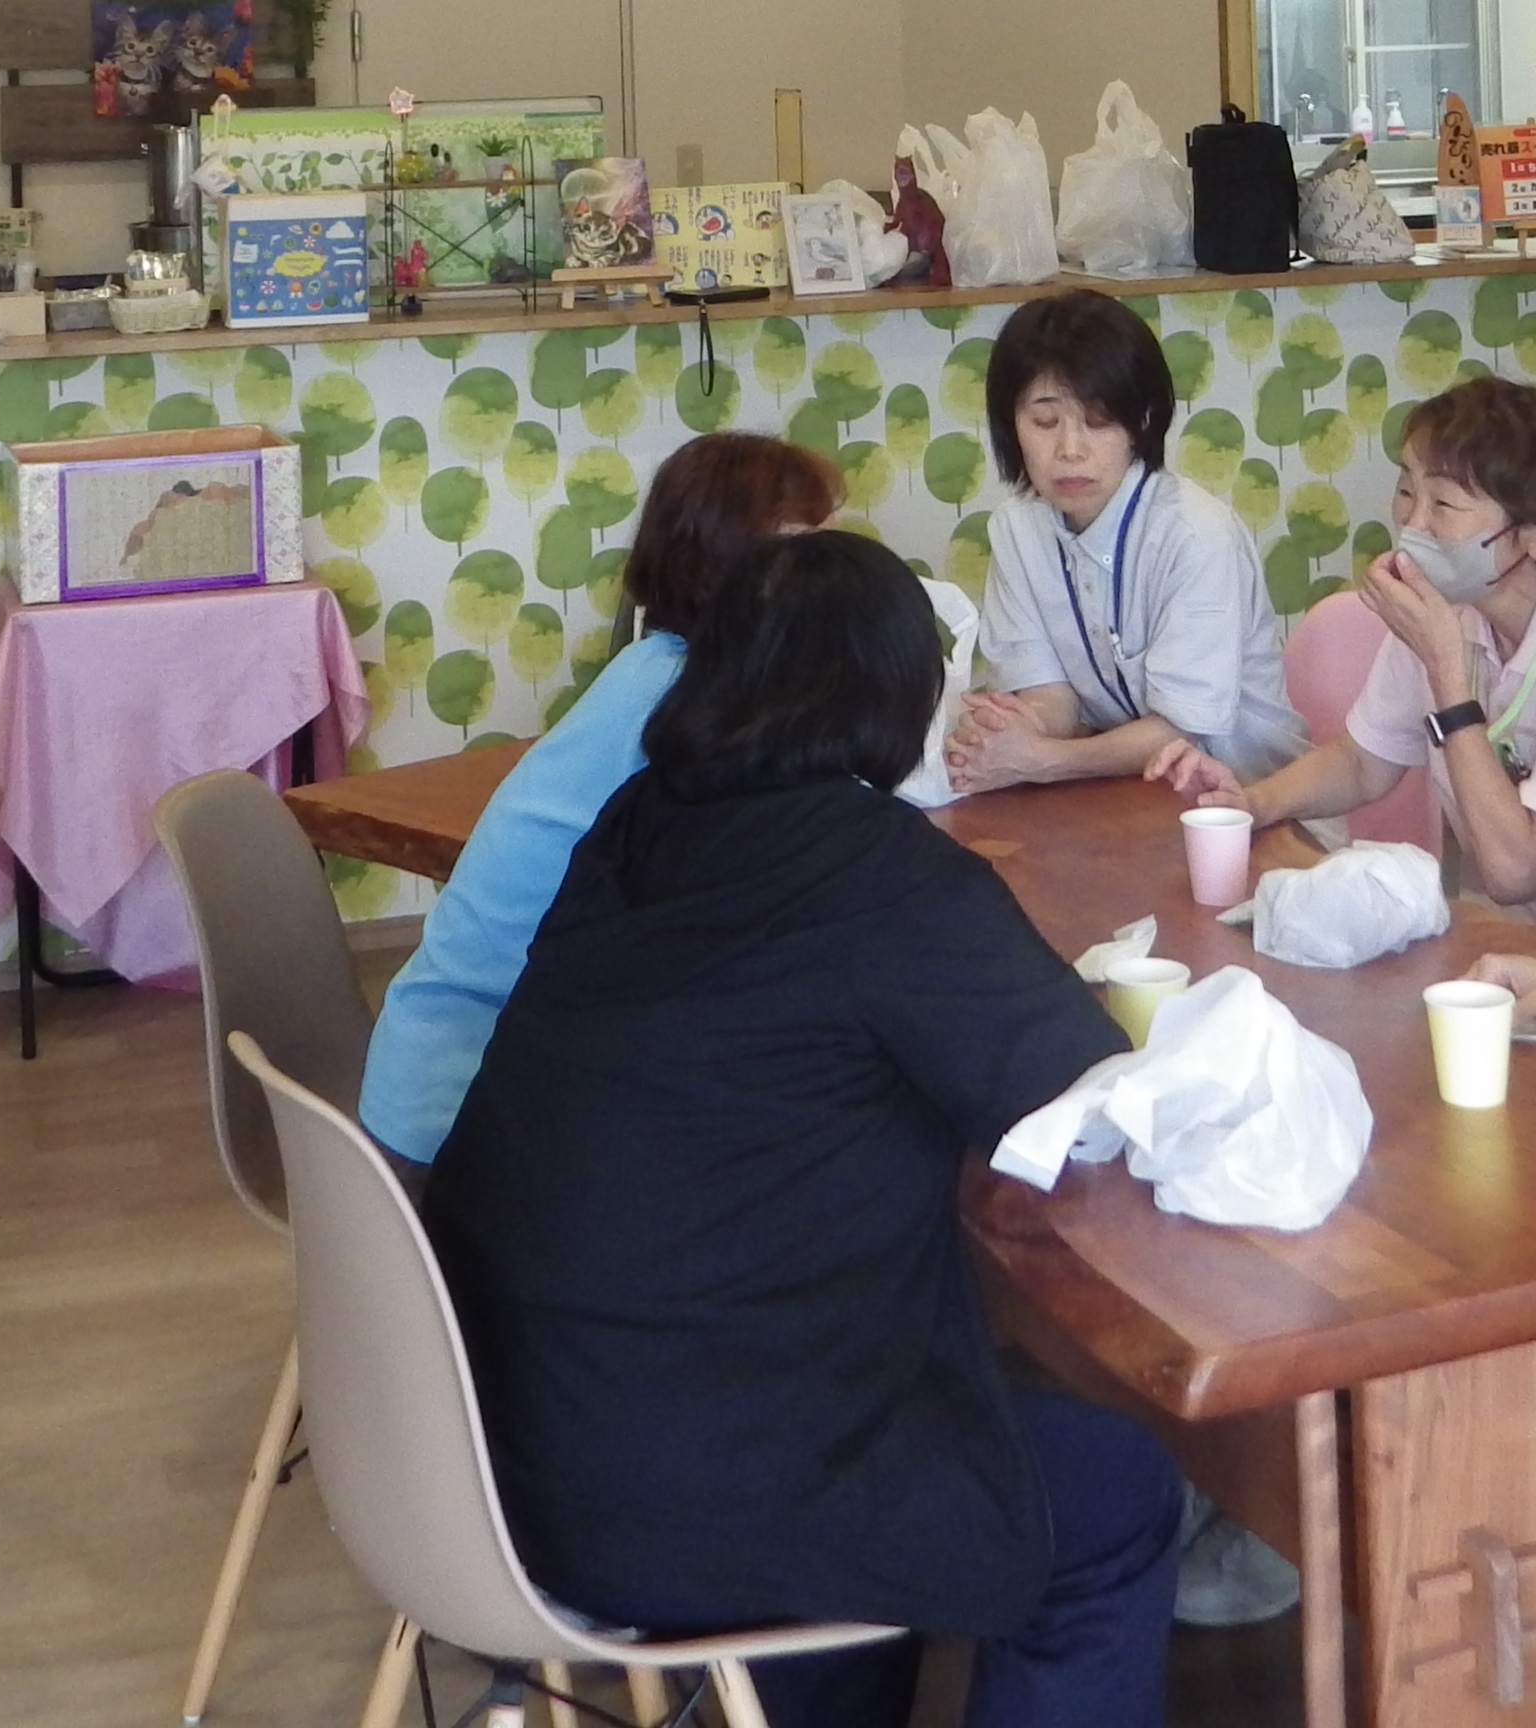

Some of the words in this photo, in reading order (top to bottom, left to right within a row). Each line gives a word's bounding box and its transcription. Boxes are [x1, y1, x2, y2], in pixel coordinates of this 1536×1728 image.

[1444, 110, 1473, 185] のんびりい
